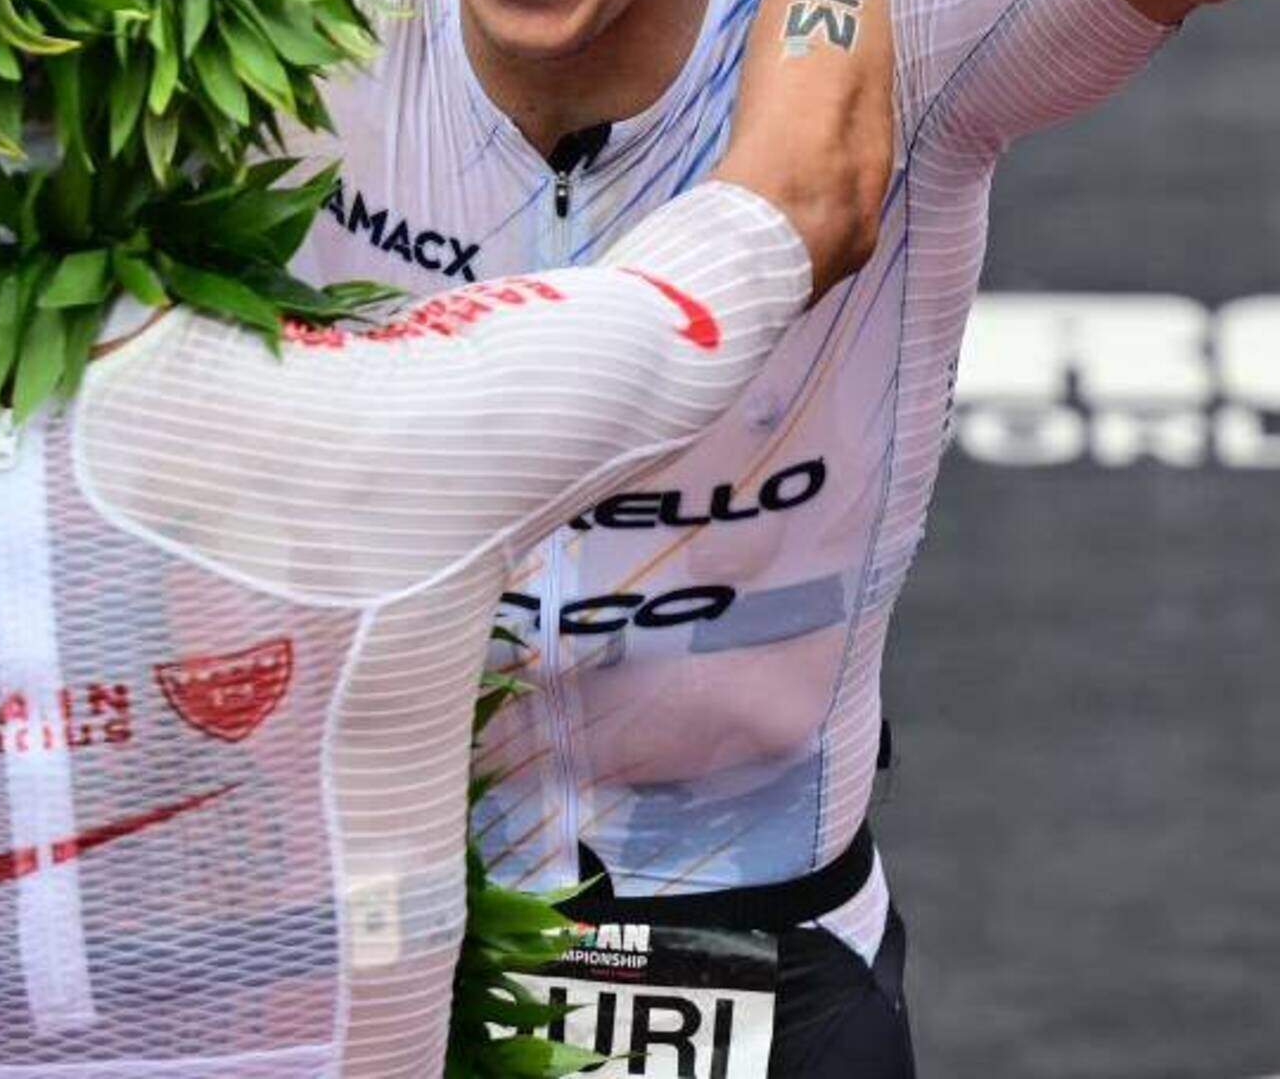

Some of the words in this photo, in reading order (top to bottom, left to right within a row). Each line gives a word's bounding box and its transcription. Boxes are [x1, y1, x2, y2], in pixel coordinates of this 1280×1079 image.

[321, 177, 480, 283] AMACX
[568, 456, 827, 530] ELLO
[517, 986, 735, 1079] URI
